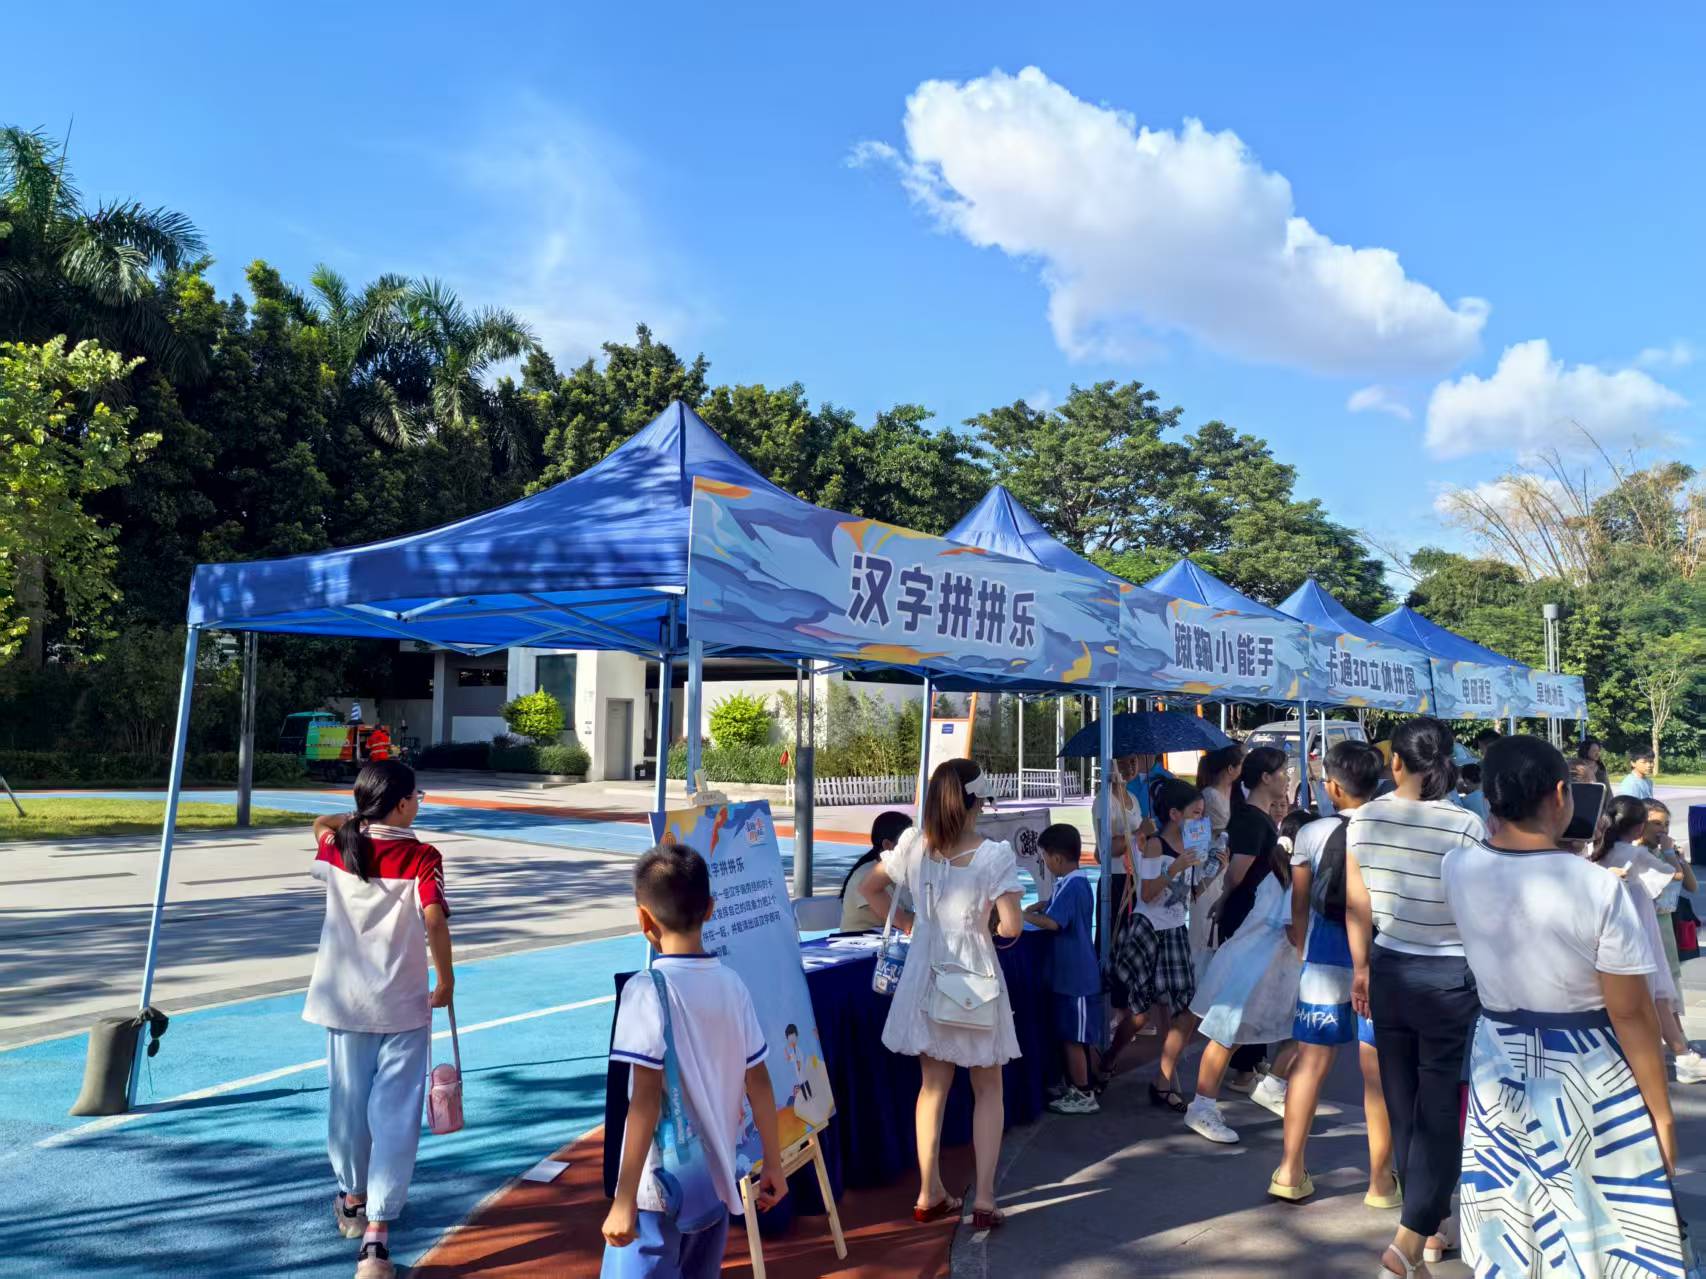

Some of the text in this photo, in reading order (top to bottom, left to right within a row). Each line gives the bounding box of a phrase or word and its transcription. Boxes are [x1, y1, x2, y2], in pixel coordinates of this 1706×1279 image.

[849, 555, 1036, 648] 汉字拼拼乐
[1174, 622, 1274, 677] 蹴鞠小能手
[1326, 648, 1417, 696] 卡通3D立体拼图
[709, 856, 745, 879] 字拼拼乐
